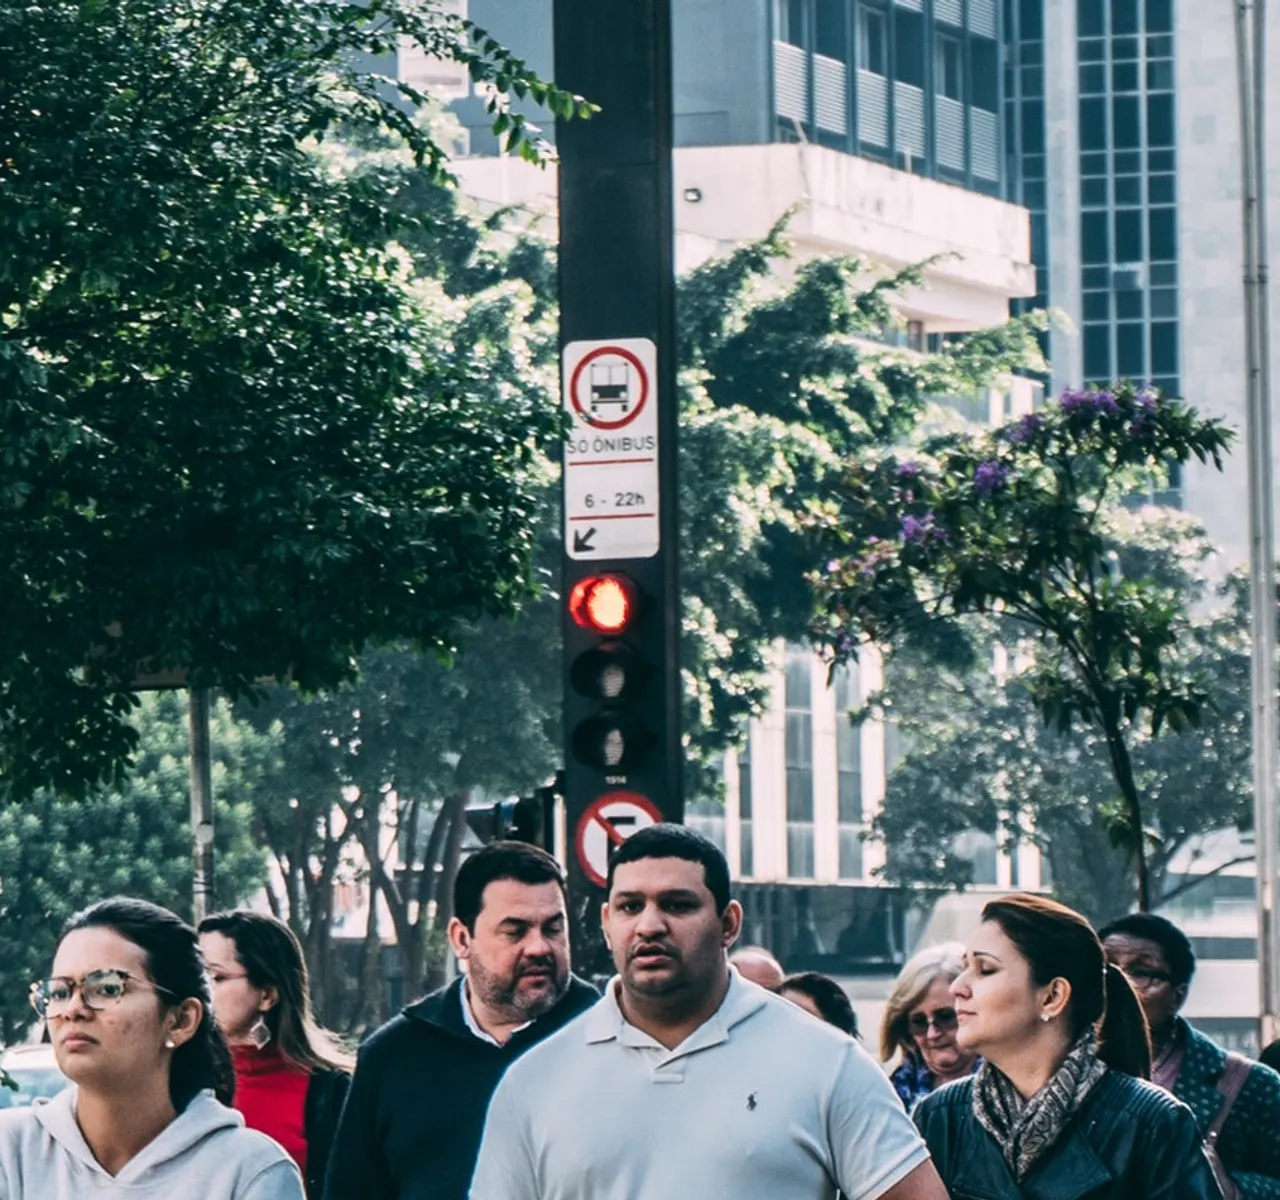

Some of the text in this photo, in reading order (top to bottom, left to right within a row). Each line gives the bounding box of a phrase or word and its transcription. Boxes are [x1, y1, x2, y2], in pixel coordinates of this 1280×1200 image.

[592, 435, 656, 454] ÔNIBUS
[584, 493, 595, 509] 6
[614, 491, 645, 508] 22h
